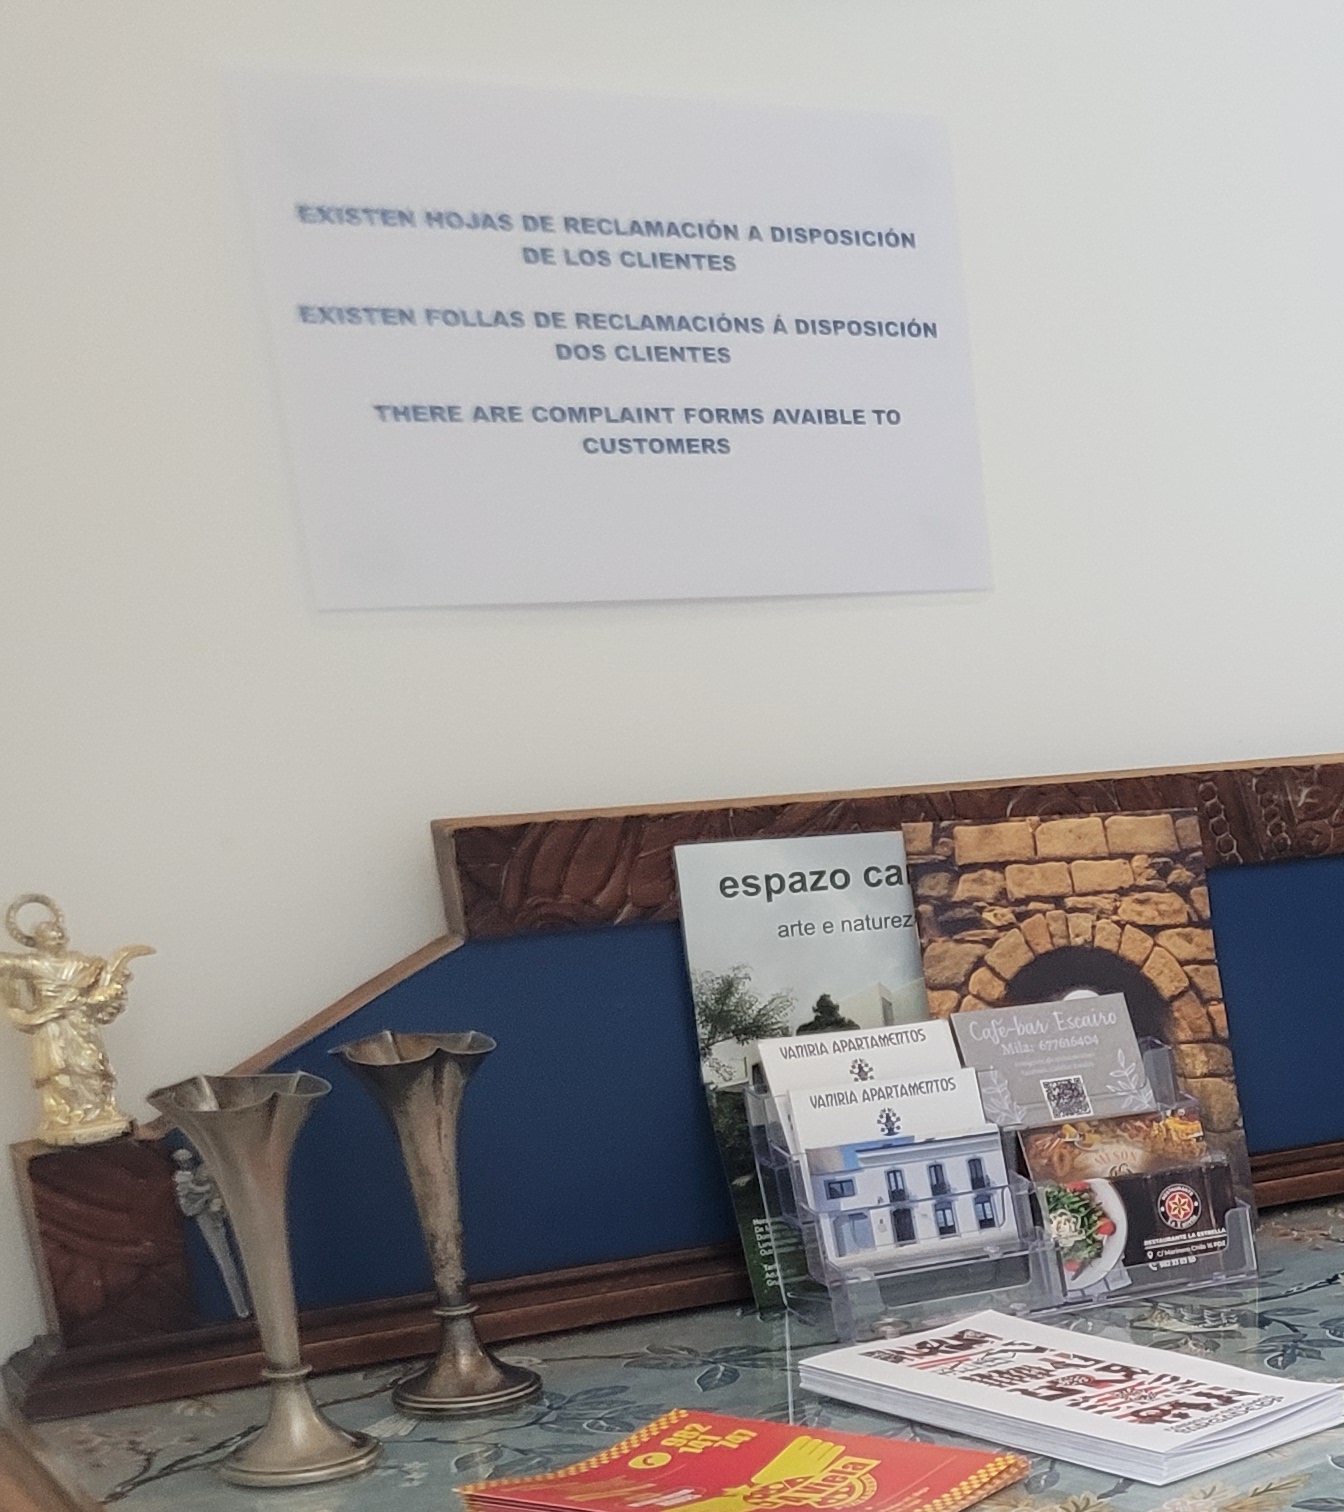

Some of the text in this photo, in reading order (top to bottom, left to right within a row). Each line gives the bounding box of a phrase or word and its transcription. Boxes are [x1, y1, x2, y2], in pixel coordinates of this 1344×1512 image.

[296, 206, 916, 248] EXISTEN HOJAS DE RECLAMACIÓN A DISPOSICIÓN
[522, 247, 736, 271] DE LOS CLIENTES
[299, 306, 415, 325] EXISTEN
[425, 309, 524, 327] FOLLAS
[534, 311, 566, 329] DE
[575, 313, 764, 333] RECLAMACIÓNS
[795, 319, 937, 337] DISPOSICIÓN
[556, 344, 730, 363] DOS CLIENTES
[374, 405, 900, 425] THERE ARE COMPLAINT FORMS AVAIBLE TO
[583, 438, 730, 454] CUSTOMERS
[720, 863, 909, 901] espazo ca
[778, 912, 919, 938] arte e naturez
[1052, 1009, 1116, 1031] Escairo
[780, 1029, 926, 1059] VANIRIA APARTAMENTOS
[810, 1078, 956, 1108] VANIRIA APARTAMENTOS
[660, 1423, 712, 1447] 982
